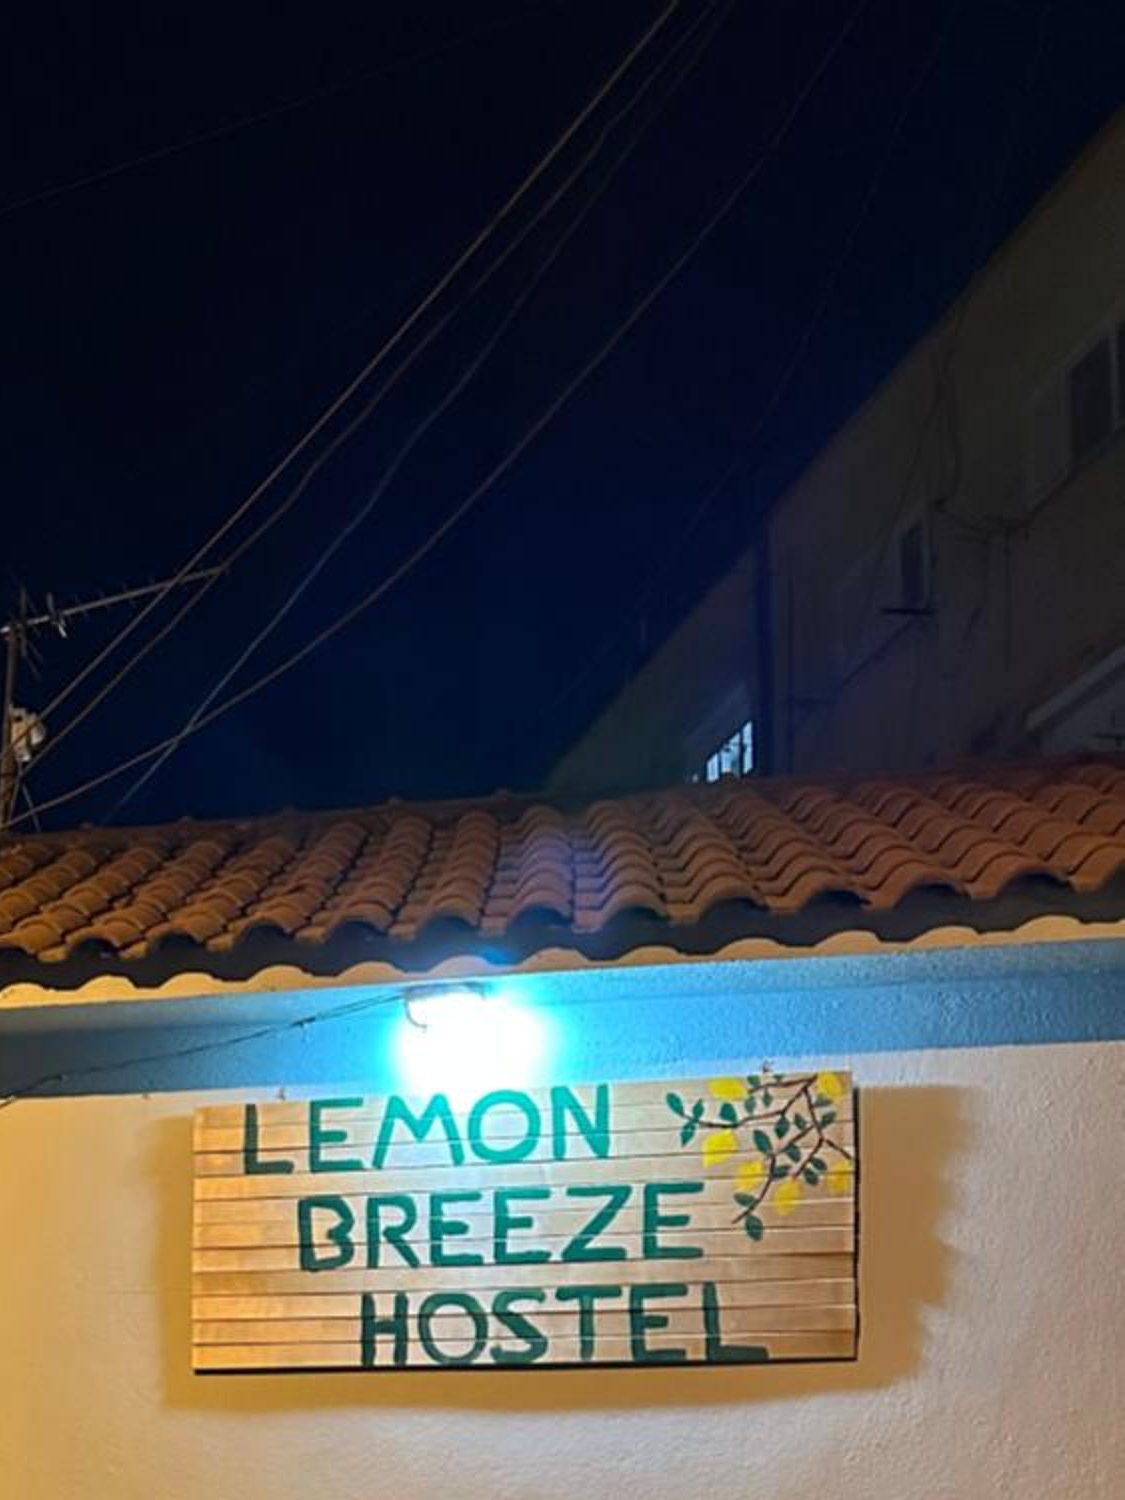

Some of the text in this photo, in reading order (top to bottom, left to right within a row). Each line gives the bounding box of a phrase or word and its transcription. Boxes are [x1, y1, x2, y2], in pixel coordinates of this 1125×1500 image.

[243, 1084, 611, 1174] LEMON
[298, 1181, 704, 1272] BREEZE
[361, 1281, 768, 1367] HOSTEL
